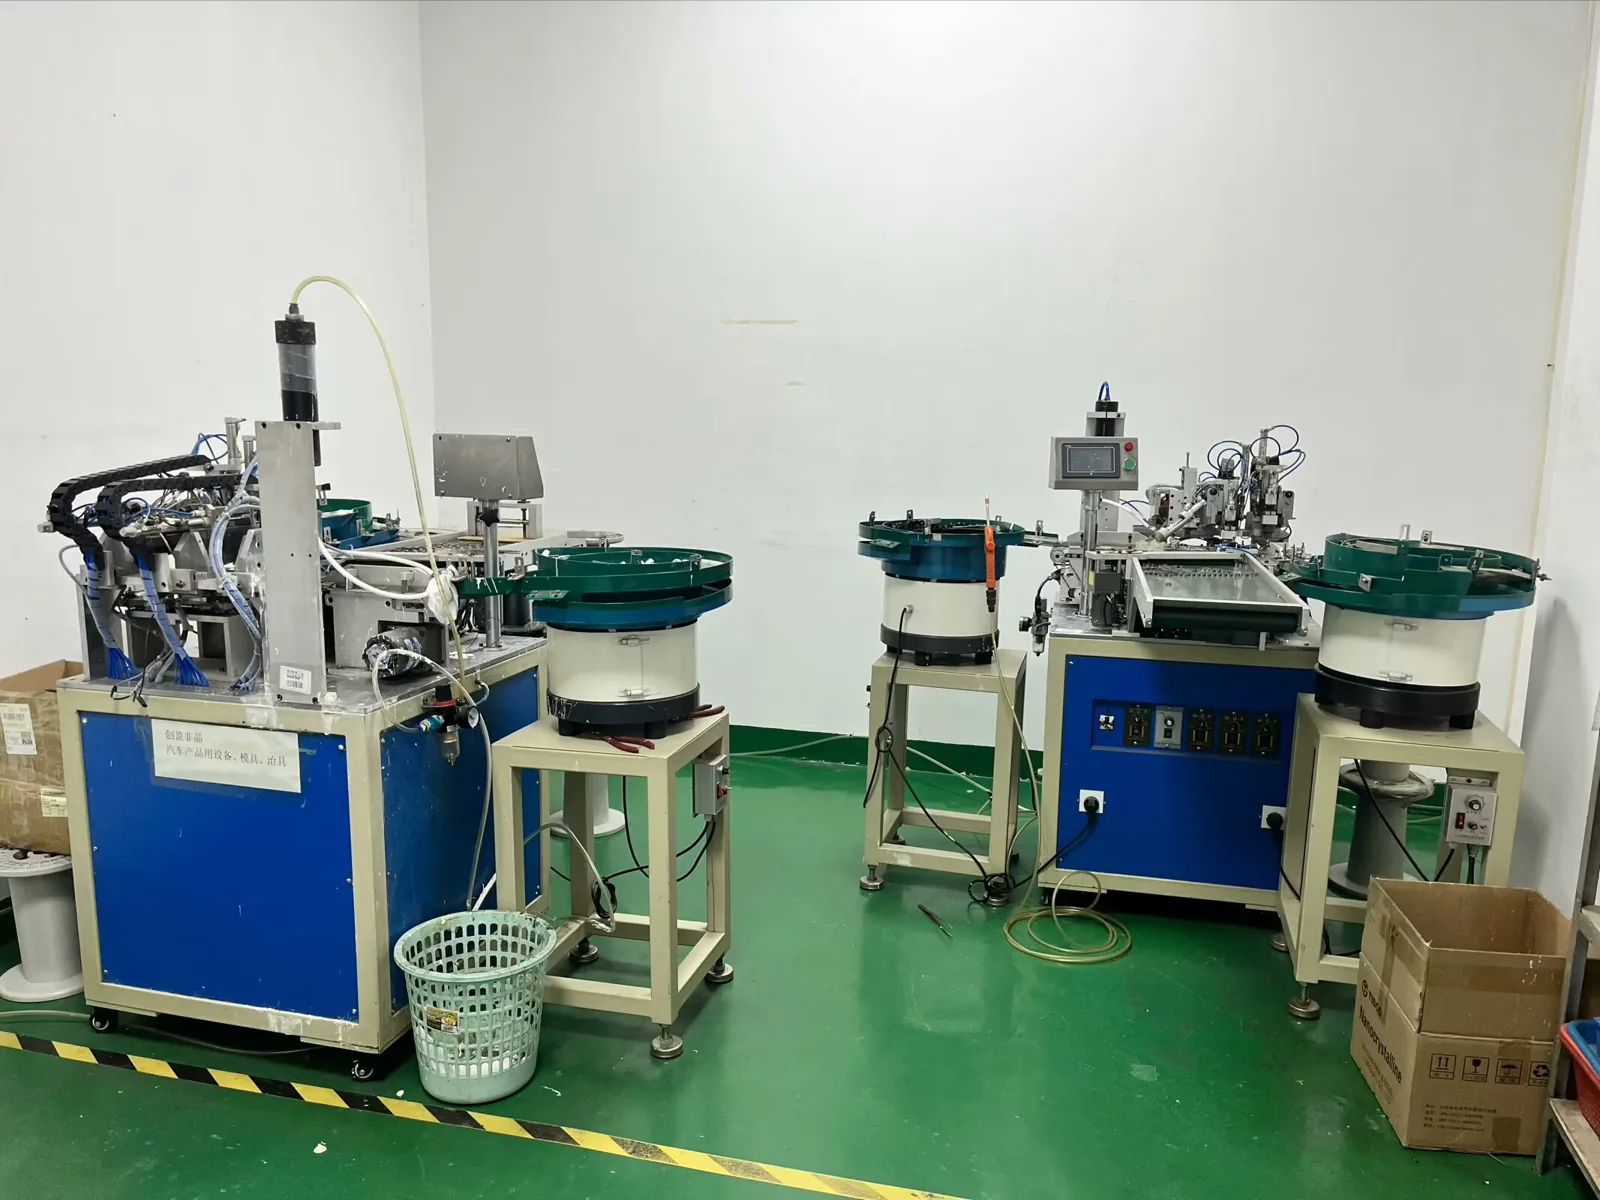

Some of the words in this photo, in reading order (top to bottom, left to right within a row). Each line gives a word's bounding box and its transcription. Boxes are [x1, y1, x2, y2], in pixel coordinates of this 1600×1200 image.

[166, 744, 287, 767] 汽车产品用设备、模具、治具
[1359, 1004, 1402, 1084] Nanocrystalline
